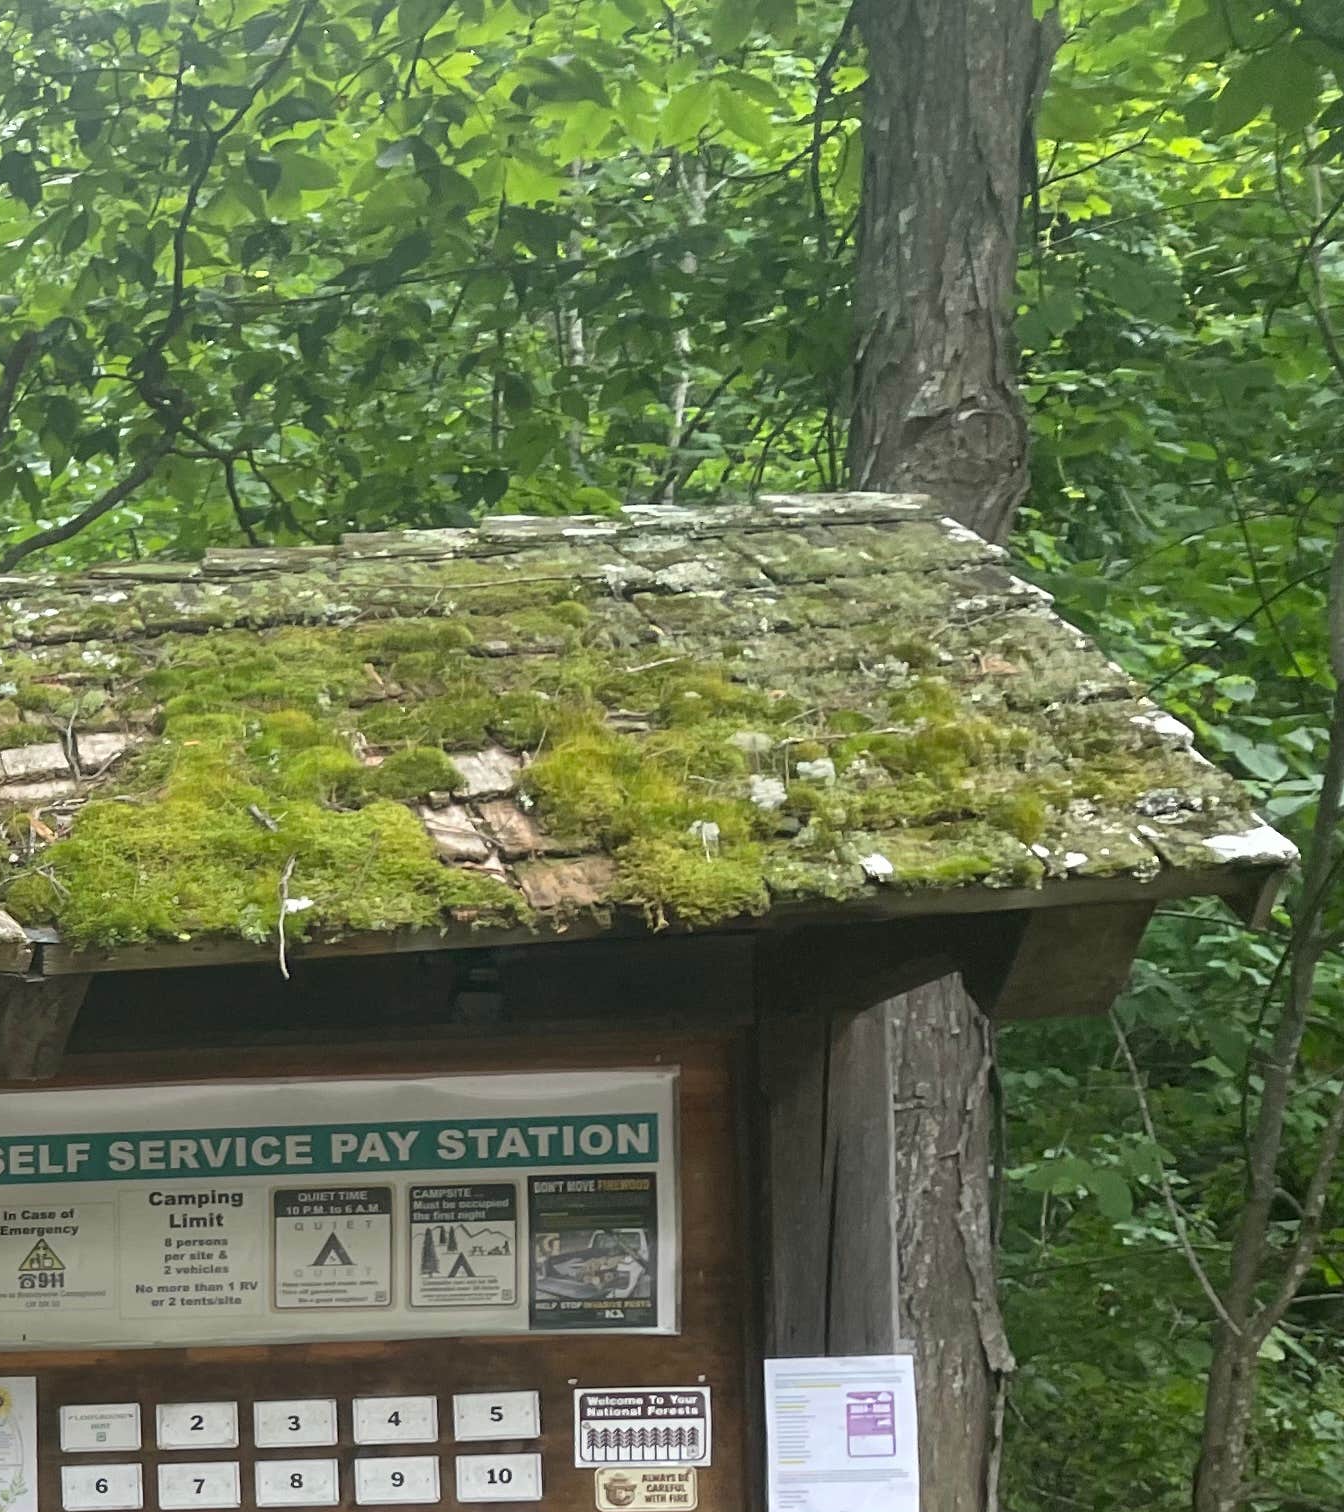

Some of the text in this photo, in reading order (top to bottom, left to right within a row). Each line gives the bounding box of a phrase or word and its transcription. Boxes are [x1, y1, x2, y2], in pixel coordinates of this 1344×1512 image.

[108, 1134, 313, 1172] SERVICE
[331, 1130, 419, 1164] PAY
[437, 1122, 650, 1161] STATION
[148, 1190, 244, 1208] Camping
[4, 1208, 75, 1221] In Case of
[168, 1212, 224, 1229] Limit
[0, 1223, 79, 1237] Emergency
[38, 1272, 65, 1288] 911
[587, 1395, 698, 1406] Welcome To Your
[387, 1411, 402, 1427] 4
[490, 1406, 504, 1422] 5
[587, 1406, 699, 1417] National Forests
[190, 1415, 204, 1431] 2
[288, 1415, 301, 1431] 3
[290, 1473, 303, 1488] 8
[390, 1472, 405, 1488] 9
[486, 1468, 513, 1484] 10
[95, 1478, 108, 1493] 6
[193, 1479, 206, 1494] 7
